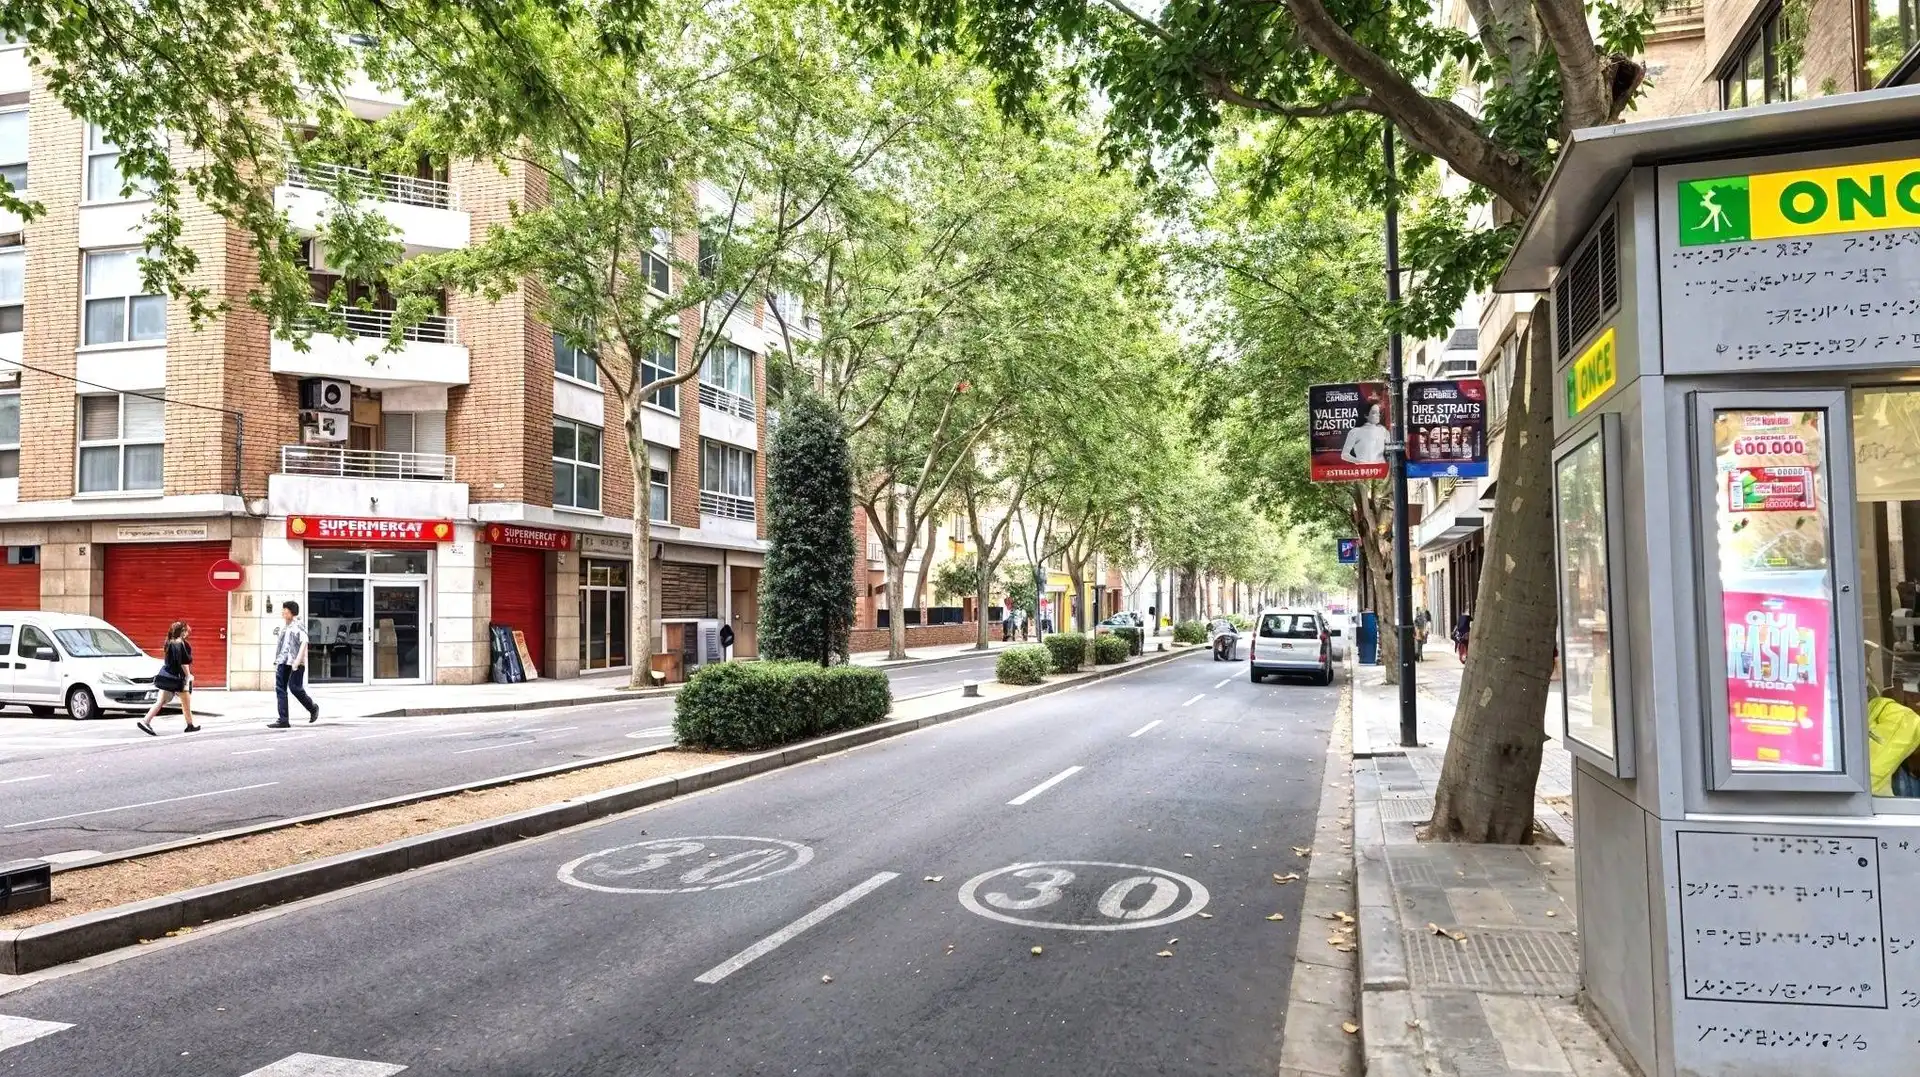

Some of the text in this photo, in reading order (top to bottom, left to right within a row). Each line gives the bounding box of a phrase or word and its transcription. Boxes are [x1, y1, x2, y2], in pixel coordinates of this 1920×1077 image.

[1581, 342, 1612, 399] ONCE
[1314, 408, 1358, 419] VALERIA
[1412, 403, 1480, 414] DIRE STRAITS
[1315, 419, 1356, 430] CASTRO
[1412, 414, 1450, 424] LEGACY
[1734, 441, 1804, 455] 600.000
[319, 520, 423, 532] SUPERMERCAT
[320, 530, 373, 538] MISTER
[504, 528, 557, 542] SUPERMERCAT
[1727, 624, 1817, 685] RASCA
[591, 841, 790, 885] 30
[984, 868, 1180, 920] 30
